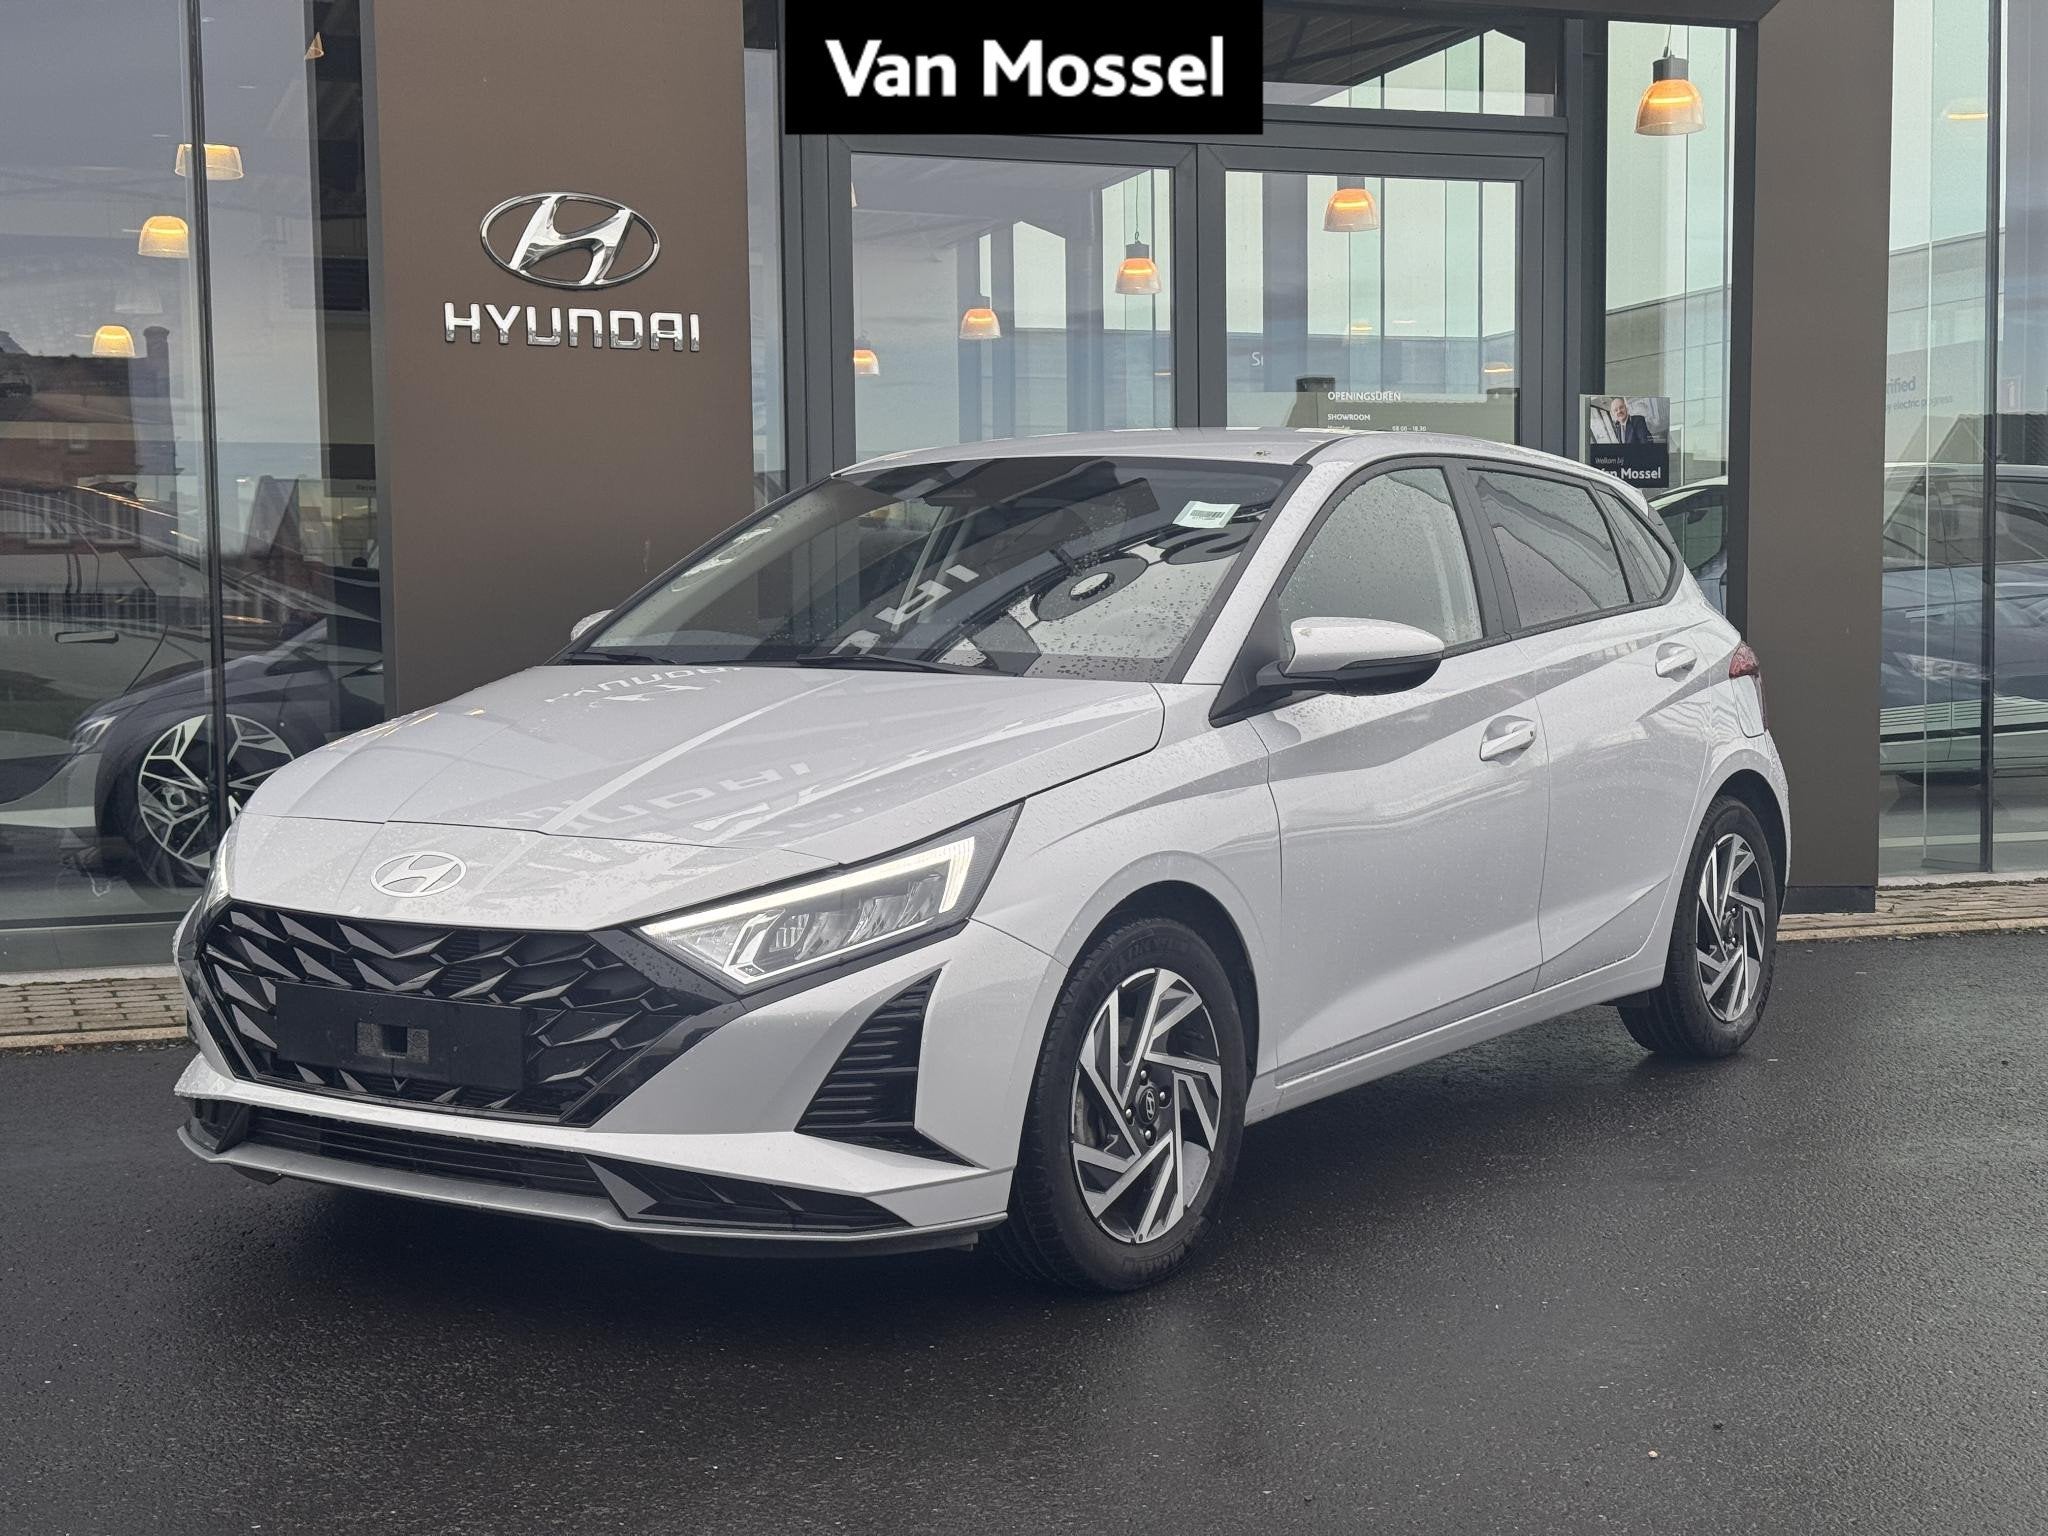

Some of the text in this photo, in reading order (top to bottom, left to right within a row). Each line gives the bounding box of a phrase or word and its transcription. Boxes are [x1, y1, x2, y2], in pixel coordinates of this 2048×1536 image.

[443, 302, 702, 353] HYUNDAI
[1327, 413, 1371, 421] SHOWROOM
[1600, 466, 1661, 479] an Mossel
